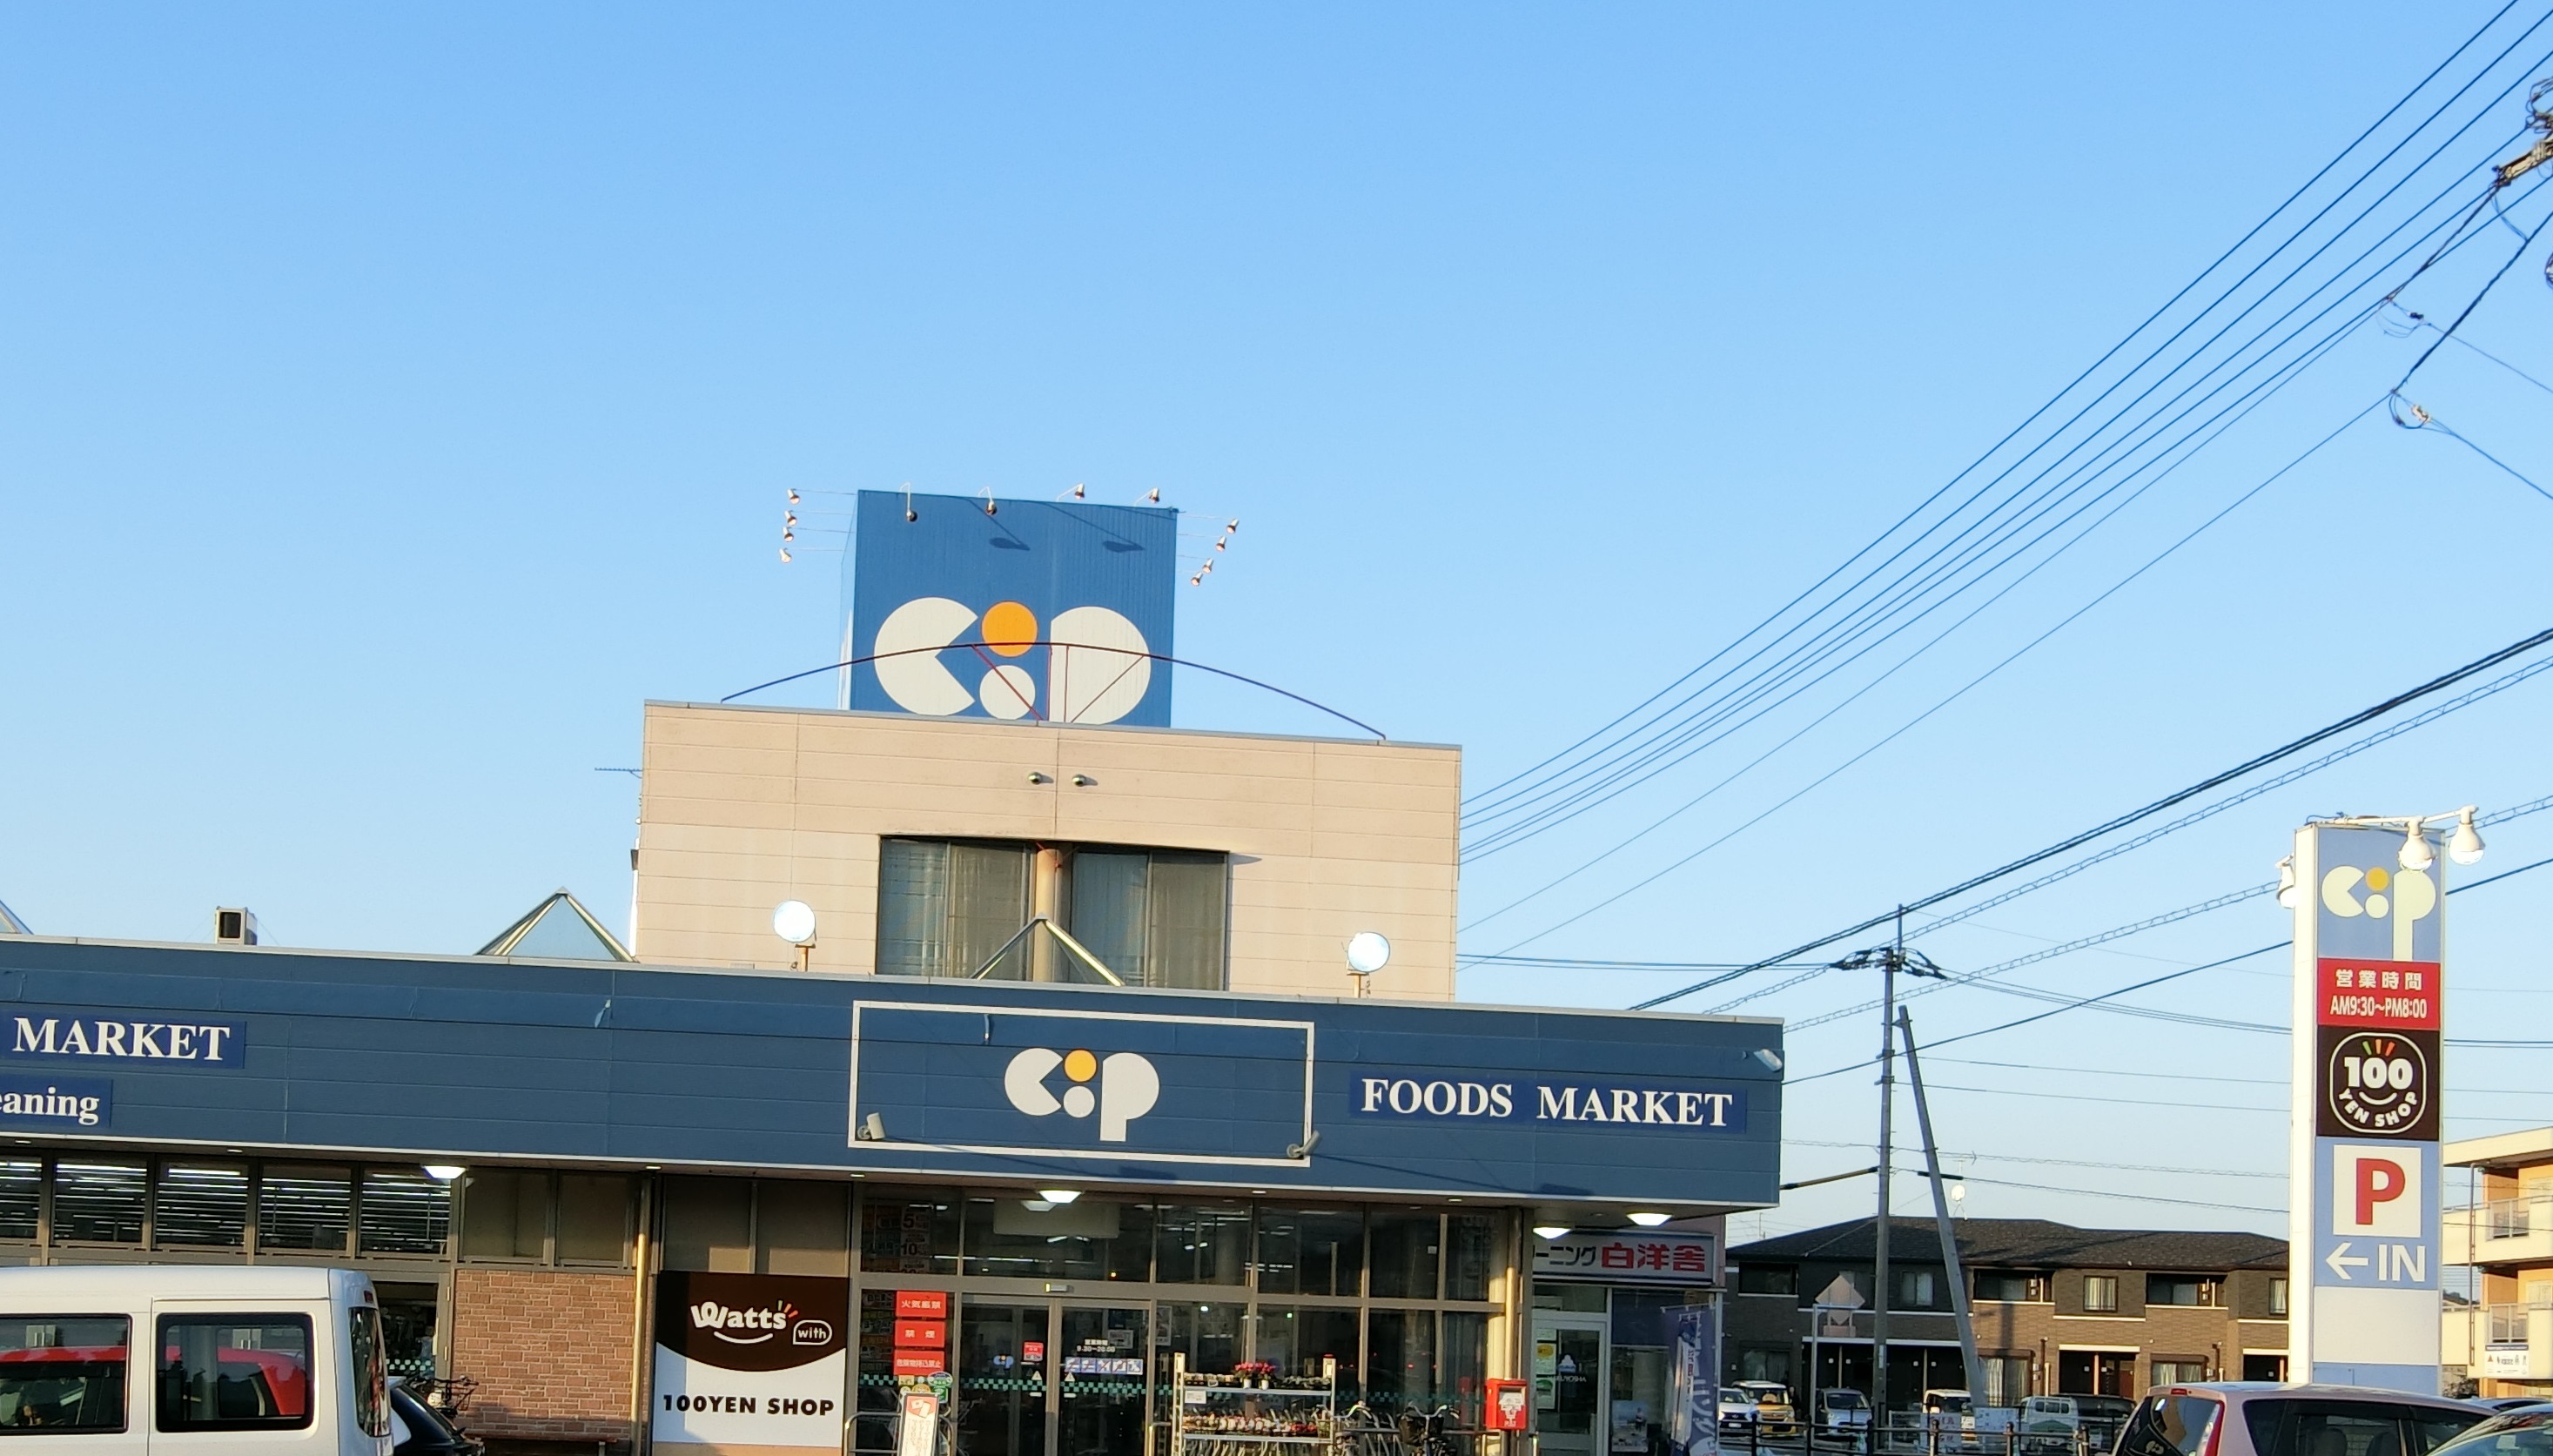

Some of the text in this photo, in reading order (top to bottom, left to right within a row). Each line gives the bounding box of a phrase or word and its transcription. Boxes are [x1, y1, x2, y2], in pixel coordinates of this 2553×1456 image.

[2335, 969, 2423, 991] 営業時間
[12, 1016, 231, 1062] MARKET
[2344, 1056, 2414, 1090] 100
[0, 1086, 100, 1126] aning
[1360, 1077, 1734, 1127] FOODS MARKET
[2338, 1087, 2419, 1129] YEN SHOP
[2355, 1157, 2406, 1225] P
[2377, 1243, 2426, 1283] IN
[690, 1301, 827, 1339] Watts with
[662, 1394, 835, 1416] 100YEN SHOP
